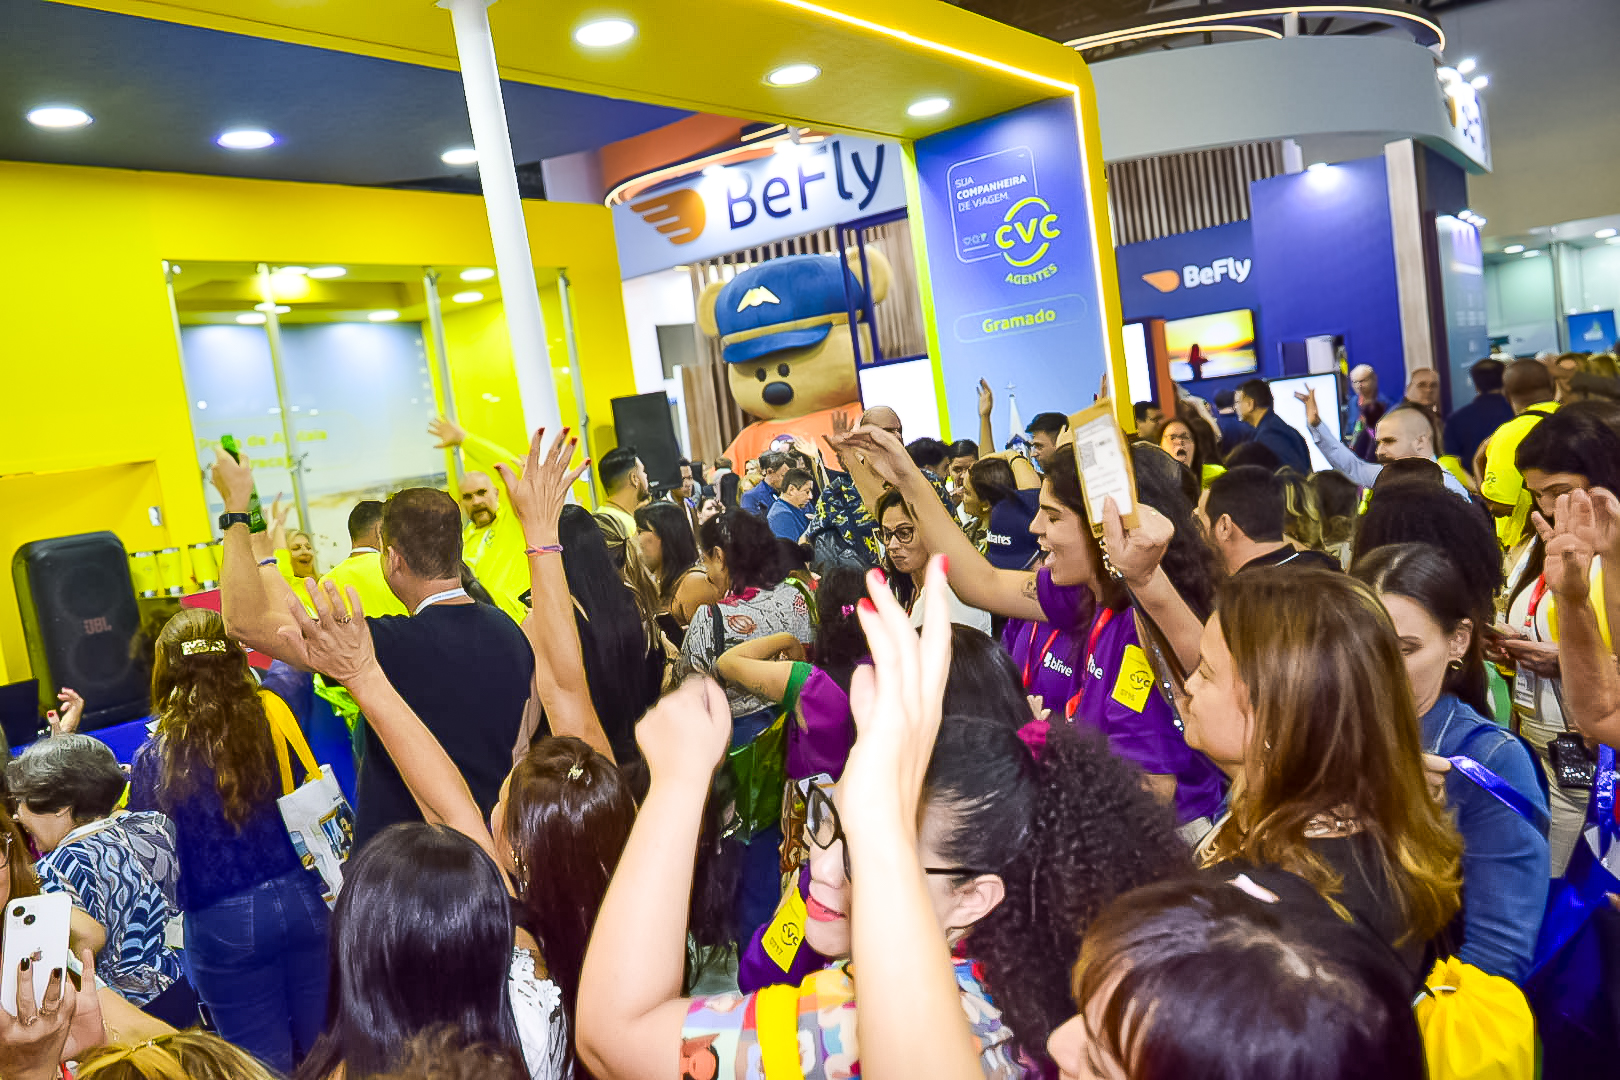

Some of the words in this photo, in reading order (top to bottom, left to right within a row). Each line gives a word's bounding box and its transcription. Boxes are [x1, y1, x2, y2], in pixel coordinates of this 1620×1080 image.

[727, 140, 885, 230] BeFly
[954, 176, 975, 189] SUA
[956, 174, 1028, 200] COMPANHEIRA
[958, 201, 972, 213] DE
[972, 191, 1009, 209] VIAGEM
[995, 213, 1061, 249] CVC
[1005, 263, 1059, 285] AGENTES
[1182, 256, 1252, 289] BeFly
[982, 308, 1057, 333] Gramado
[83, 616, 112, 635] JBL
[1129, 673, 1151, 688] CVC
[782, 923, 799, 946] CVC
